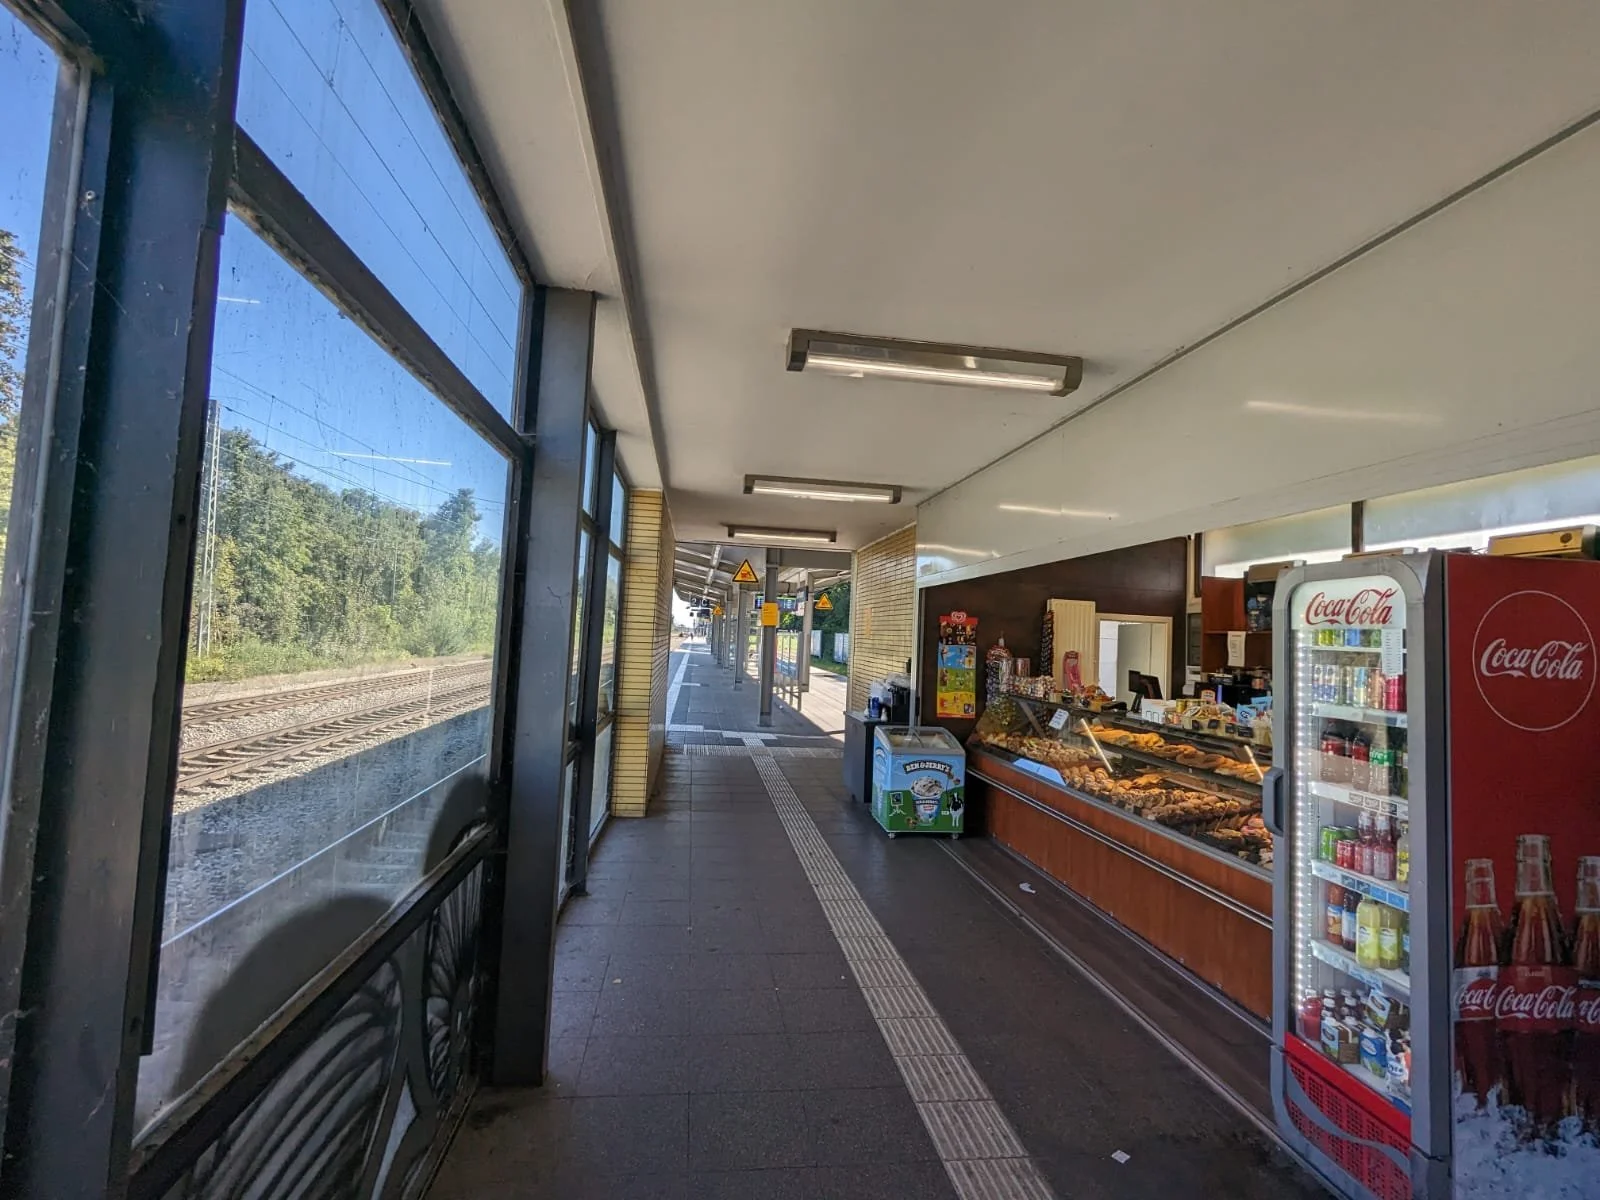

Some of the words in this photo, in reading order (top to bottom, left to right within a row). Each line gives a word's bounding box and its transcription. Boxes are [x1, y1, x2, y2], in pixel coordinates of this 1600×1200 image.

[1305, 588, 1399, 625] Coca-Cola
[1480, 638, 1589, 680] Coca-Cola
[1495, 985, 1577, 1019] Coca-Cola
